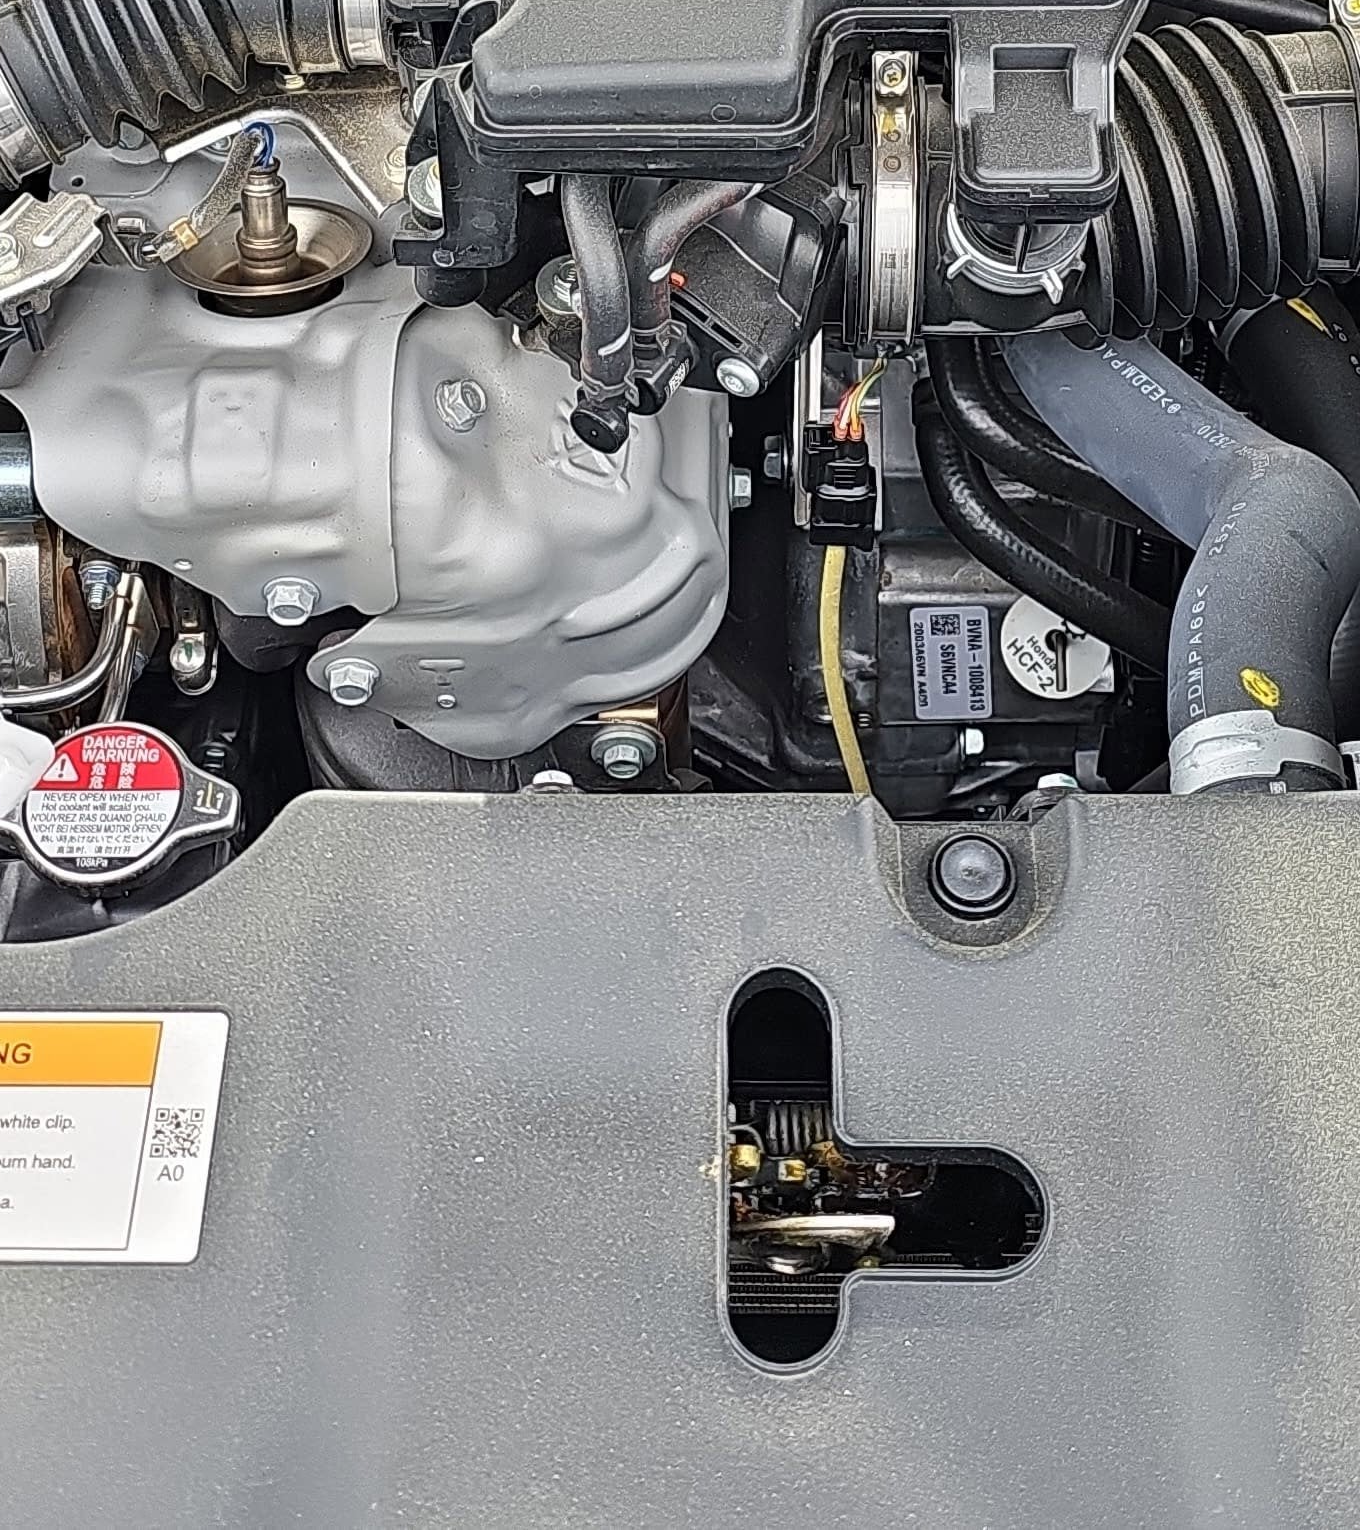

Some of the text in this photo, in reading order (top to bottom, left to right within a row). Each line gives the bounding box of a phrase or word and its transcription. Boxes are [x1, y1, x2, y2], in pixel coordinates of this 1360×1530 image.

[1209, 502, 1246, 557] 25210
[1026, 635, 1058, 671] Honda
[940, 643, 958, 695] S6VNCA4
[1006, 638, 1054, 693] HCF-2
[83, 735, 147, 749] DANGER
[82, 749, 160, 763] WARNUNG
[43, 793, 76, 802] NEVER
[79, 793, 106, 802] OPEN
[109, 793, 139, 802] WHEN
[41, 803, 56, 811] Hot
[59, 803, 90, 811] coolant
[93, 803, 106, 811] will
[108, 803, 131, 811] scald
[99, 813, 133, 822] QUAND
[0, 1115, 40, 1128] white
[46, 1115, 75, 1132] clip.
[32, 1154, 75, 1168] hand.
